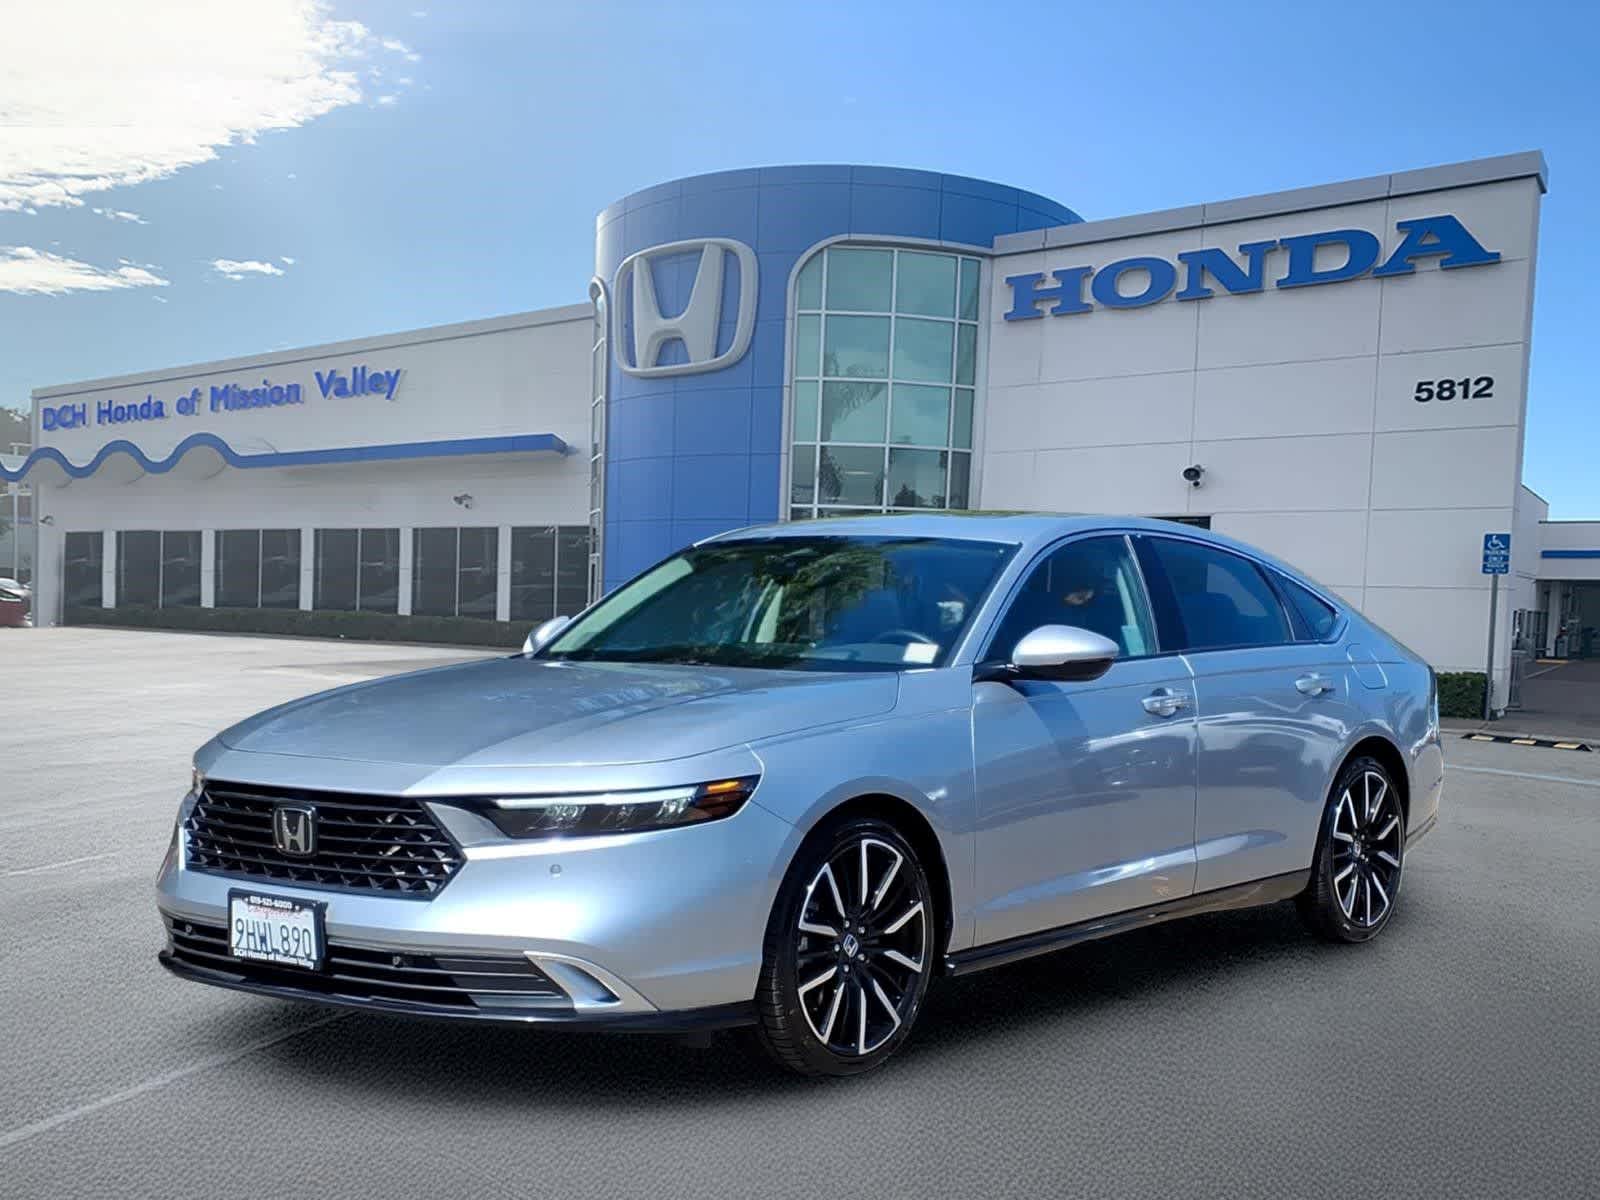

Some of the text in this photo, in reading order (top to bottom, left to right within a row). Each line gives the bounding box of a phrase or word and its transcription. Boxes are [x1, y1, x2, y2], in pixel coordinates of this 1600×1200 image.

[1004, 213, 1501, 322] HONDA
[42, 366, 401, 431] DCH Honda of Mission Valley
[1413, 376, 1494, 403] 5812
[280, 924, 312, 959] 890
